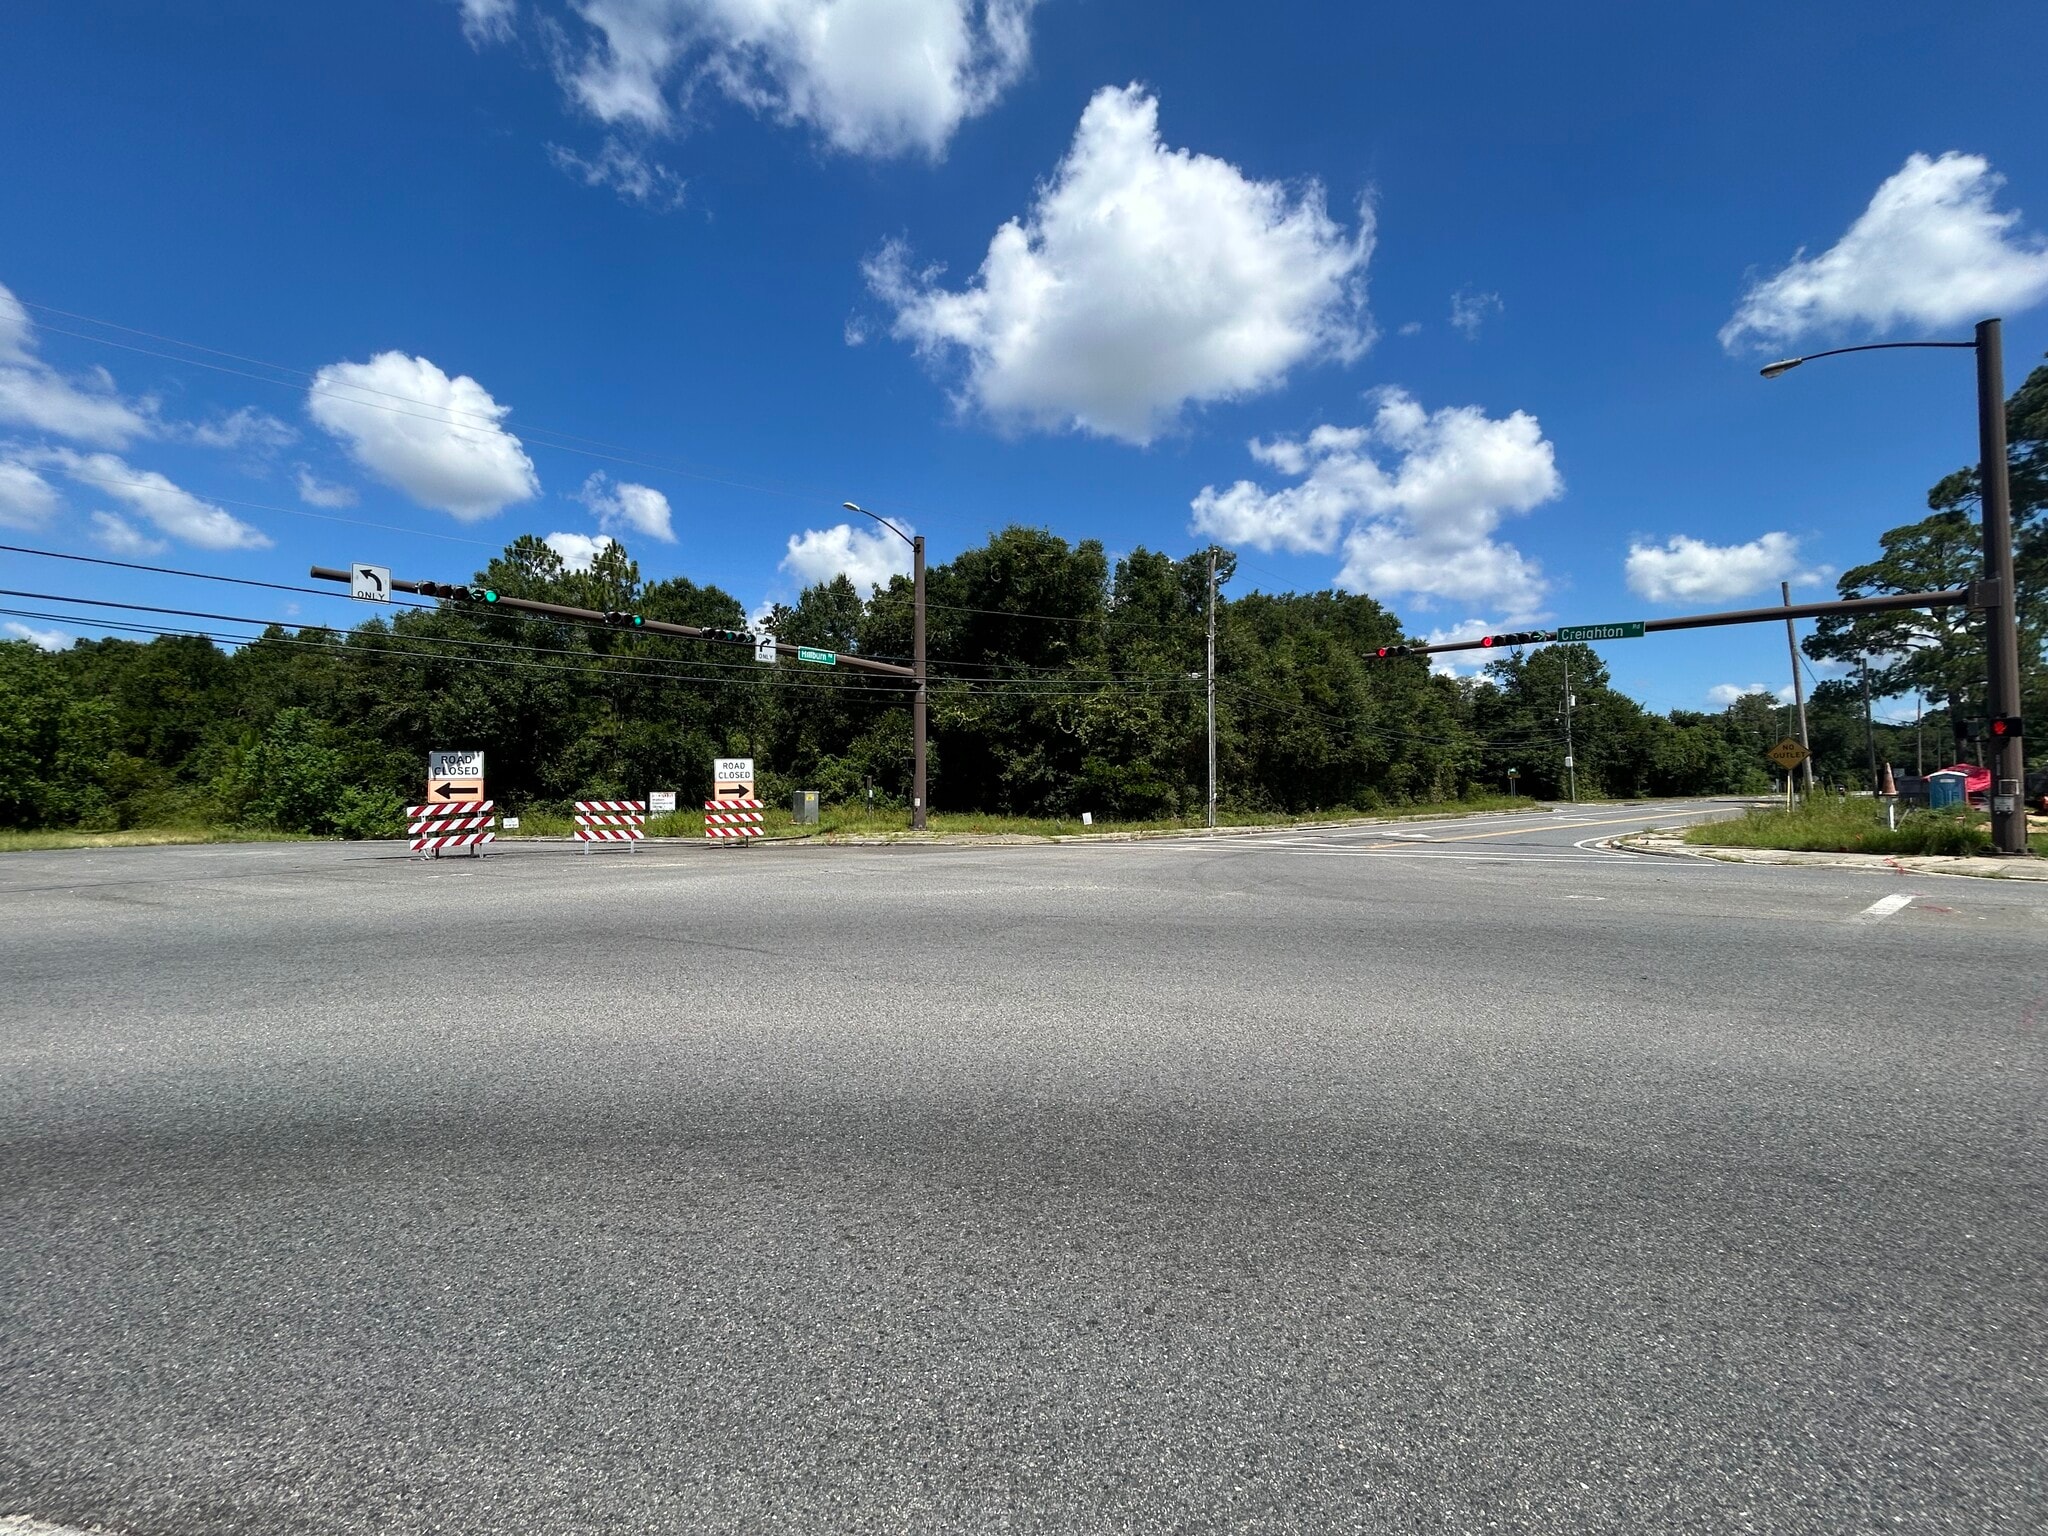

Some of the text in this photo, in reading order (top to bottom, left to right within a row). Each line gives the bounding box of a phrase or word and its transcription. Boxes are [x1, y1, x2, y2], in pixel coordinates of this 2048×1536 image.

[357, 590, 385, 600] ONLY
[1561, 626, 1624, 641] Creighton
[441, 755, 472, 764] ROAD
[1773, 751, 1806, 759] OUTLET
[722, 762, 746, 770] ROAD
[434, 766, 479, 776] CLOSED
[718, 771, 751, 779] CLOSED
